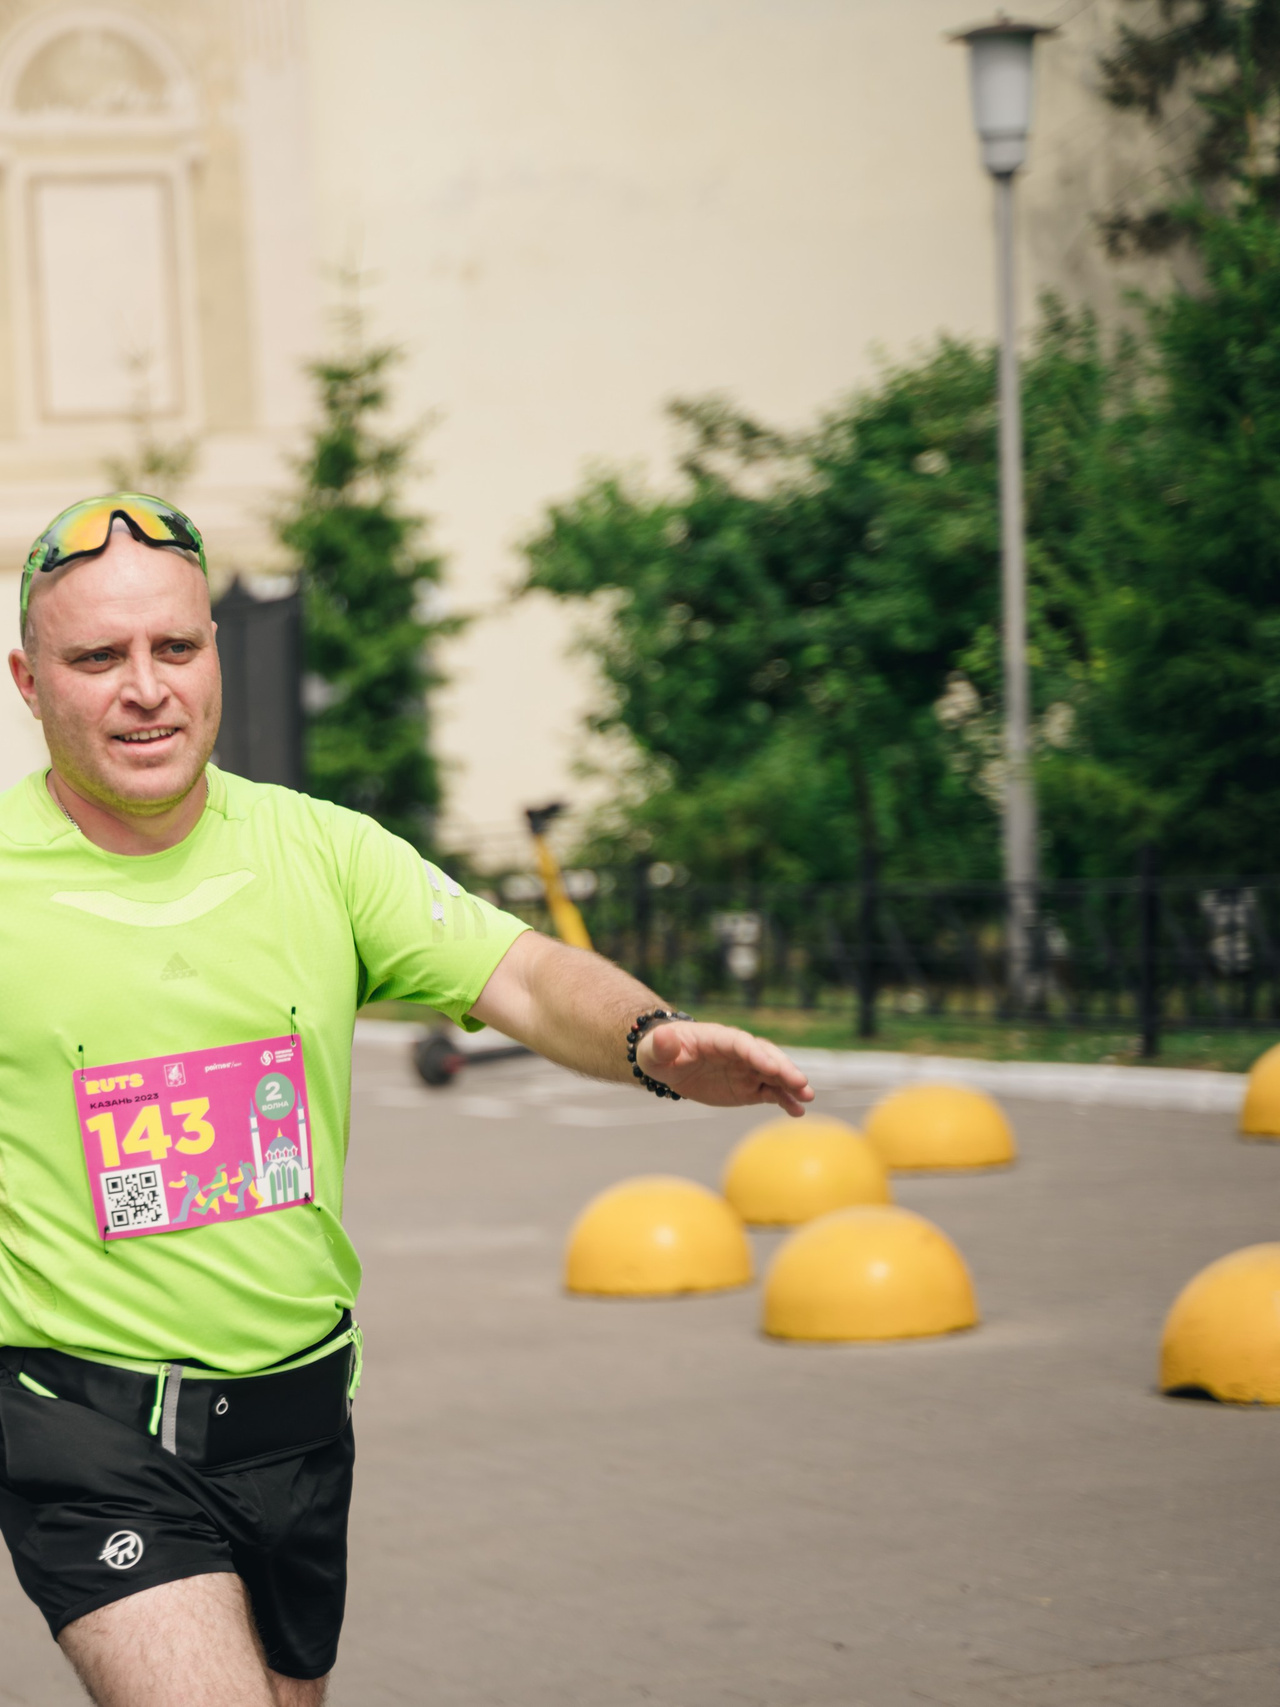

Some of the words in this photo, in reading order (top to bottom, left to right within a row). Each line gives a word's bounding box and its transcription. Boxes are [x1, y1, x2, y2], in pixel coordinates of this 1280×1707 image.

[85, 1073, 144, 1095] RUTS
[265, 1081, 282, 1102] 2
[90, 1097, 132, 1109] КАЗАНЬ
[134, 1093, 159, 1103] 2023
[262, 1100, 289, 1111] ВОЛНА
[86, 1097, 215, 1168] 143
